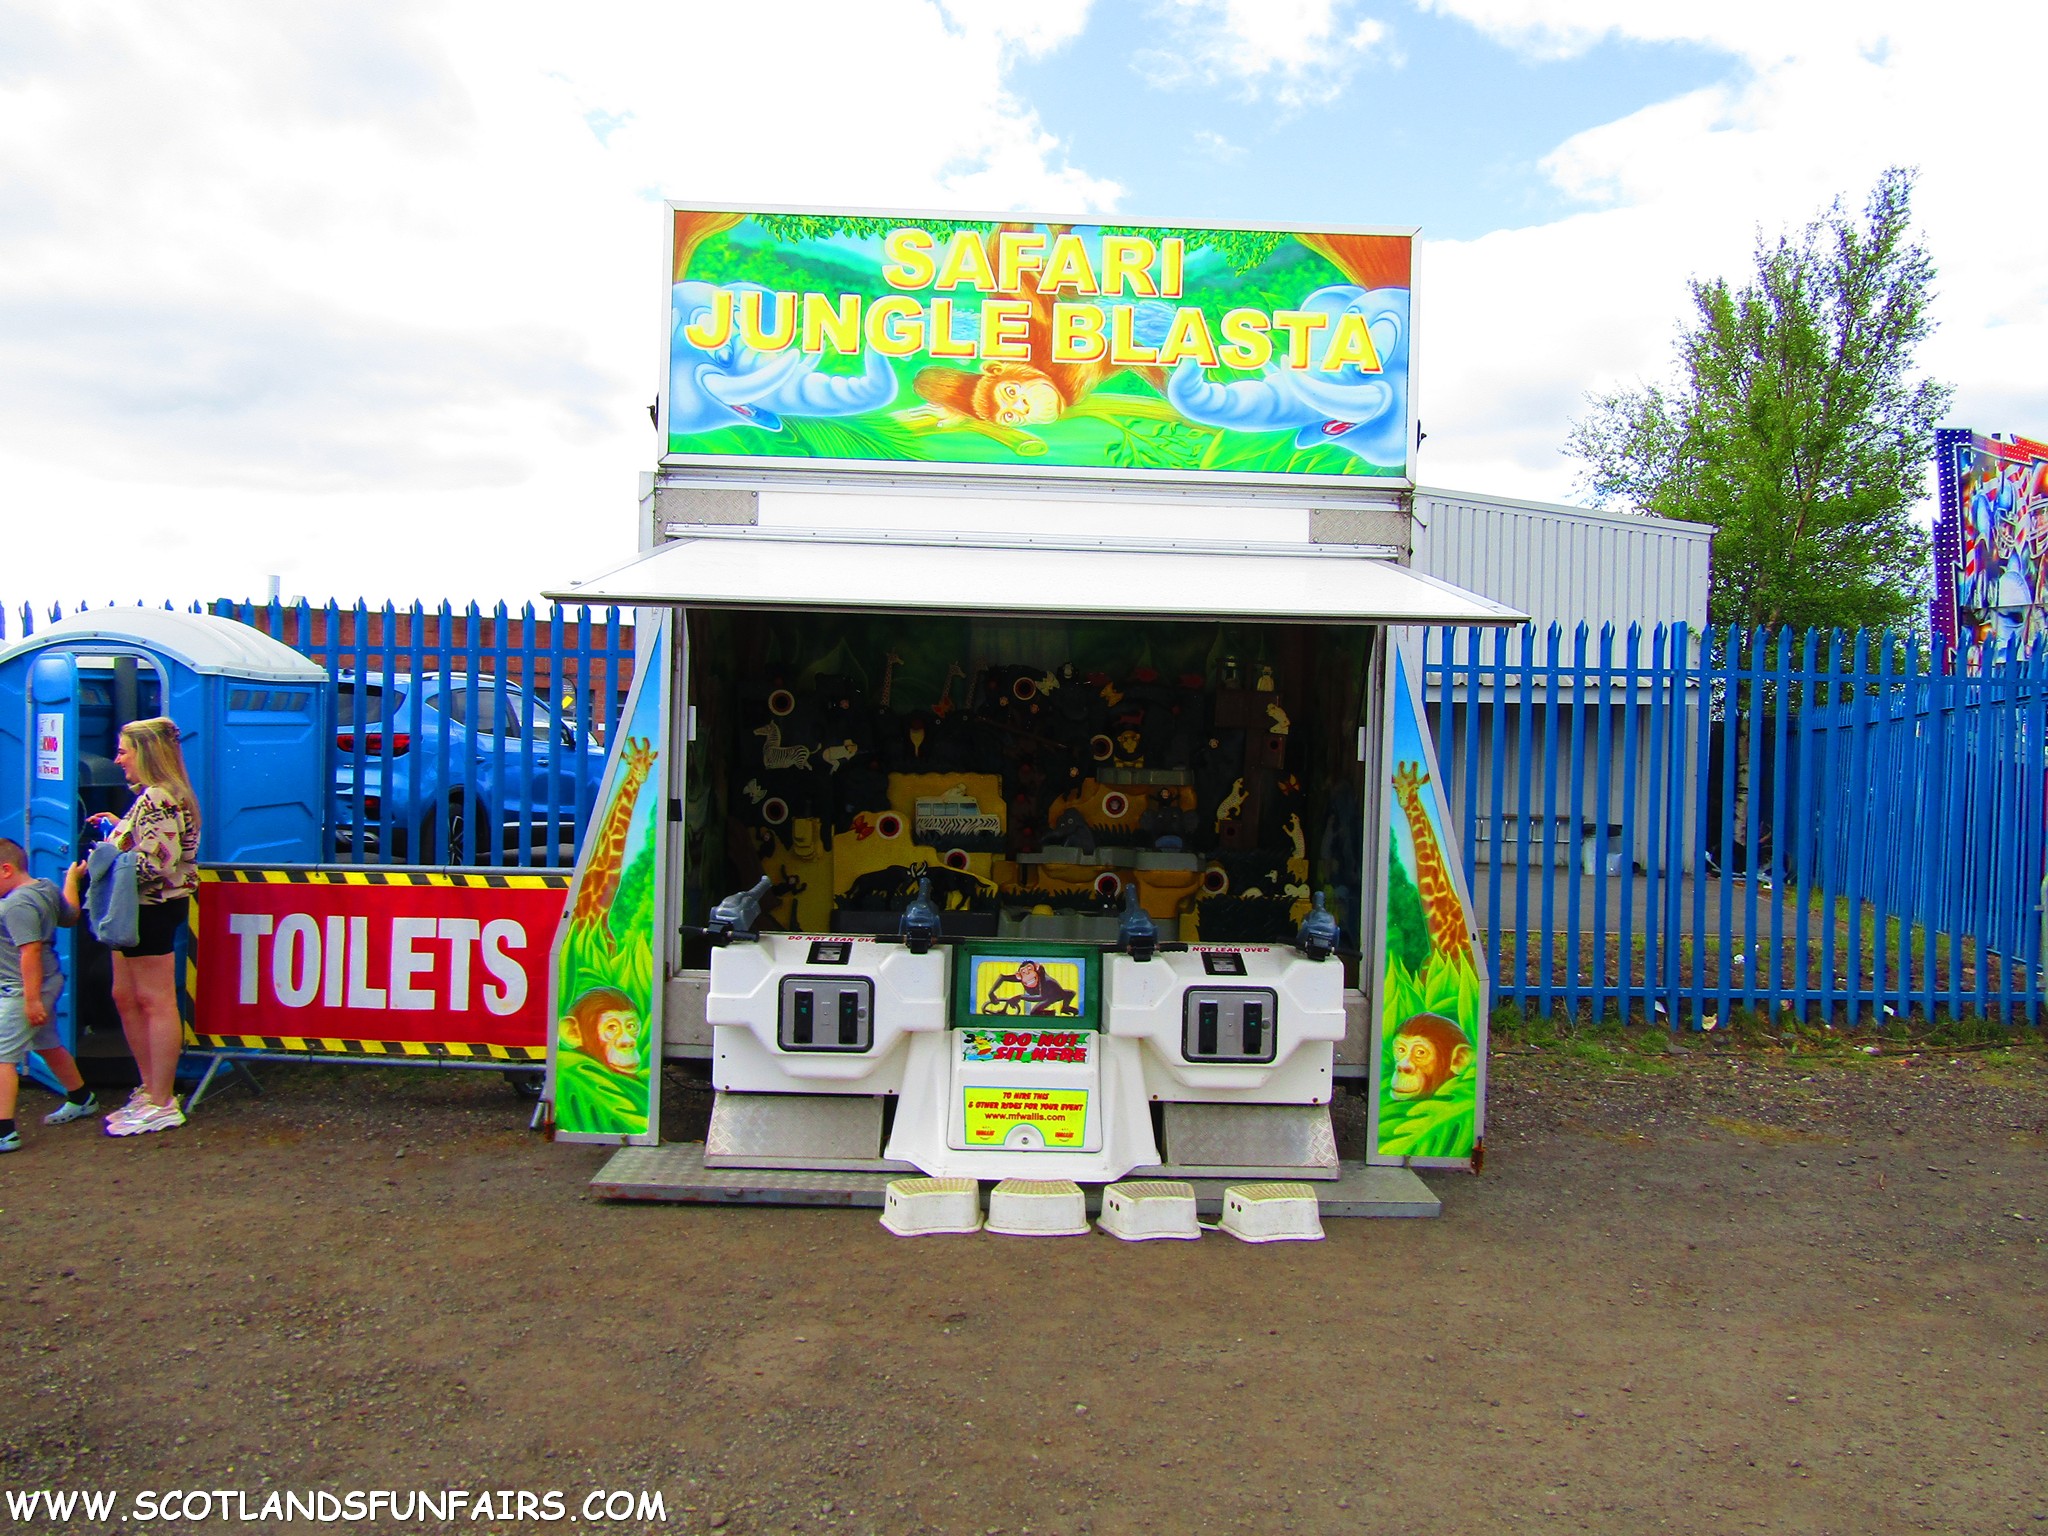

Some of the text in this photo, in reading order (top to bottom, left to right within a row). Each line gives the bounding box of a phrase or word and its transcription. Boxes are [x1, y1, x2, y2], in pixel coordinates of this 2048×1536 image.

[882, 228, 1186, 300] SAFARI
[684, 289, 1384, 376] JUNGLE BLASTA
[229, 913, 528, 1016] TOILETS
[1003, 1033, 1080, 1046] DO NOT
[994, 1047, 1087, 1062] SIT HERE
[1014, 1092, 1031, 1100] HIRE
[976, 1101, 999, 1109] OTHER
[1040, 1103, 1059, 1111] YOUR
